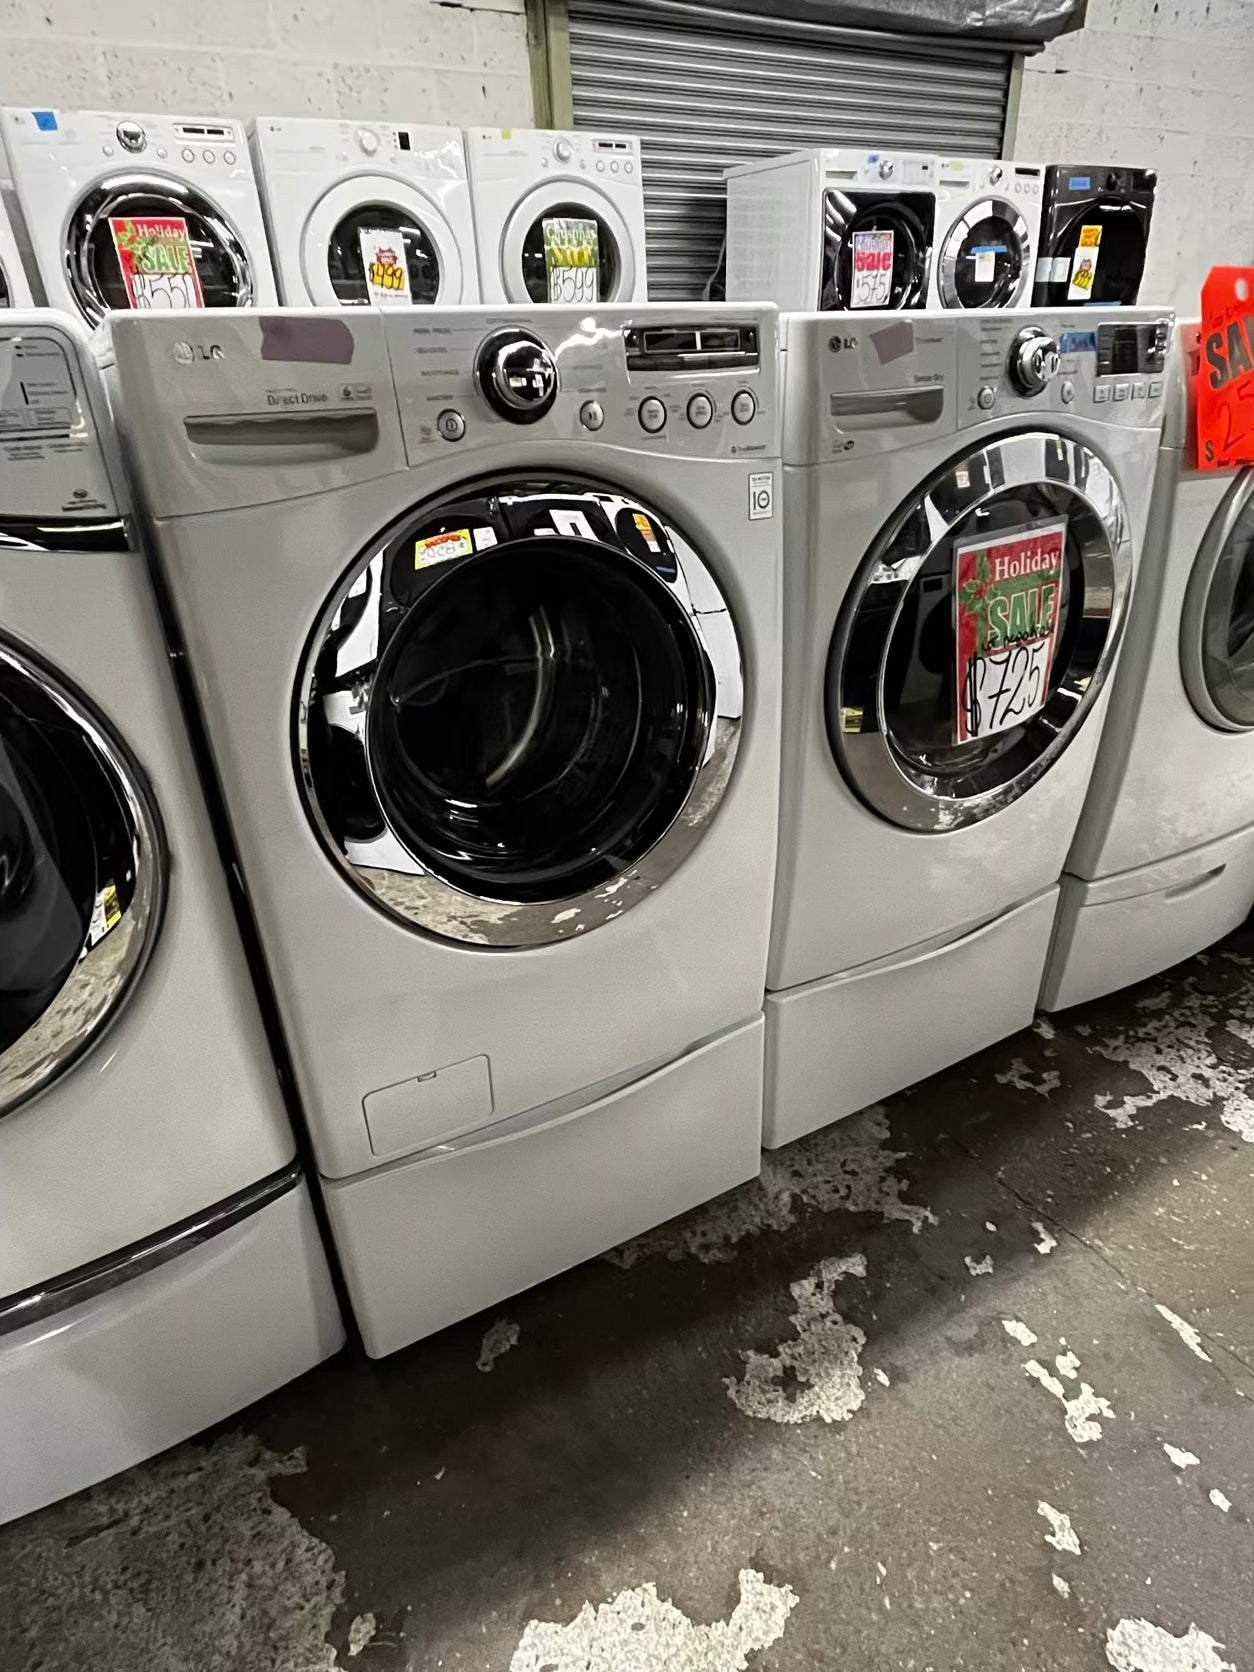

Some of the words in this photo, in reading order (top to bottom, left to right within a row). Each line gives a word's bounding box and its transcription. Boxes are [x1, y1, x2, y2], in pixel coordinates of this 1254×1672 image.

[136, 223, 186, 242] Holiday
[139, 243, 192, 273] SALE
[994, 548, 1060, 580] Holiday
[987, 583, 1055, 650] SALE
[962, 641, 1045, 737] $725
